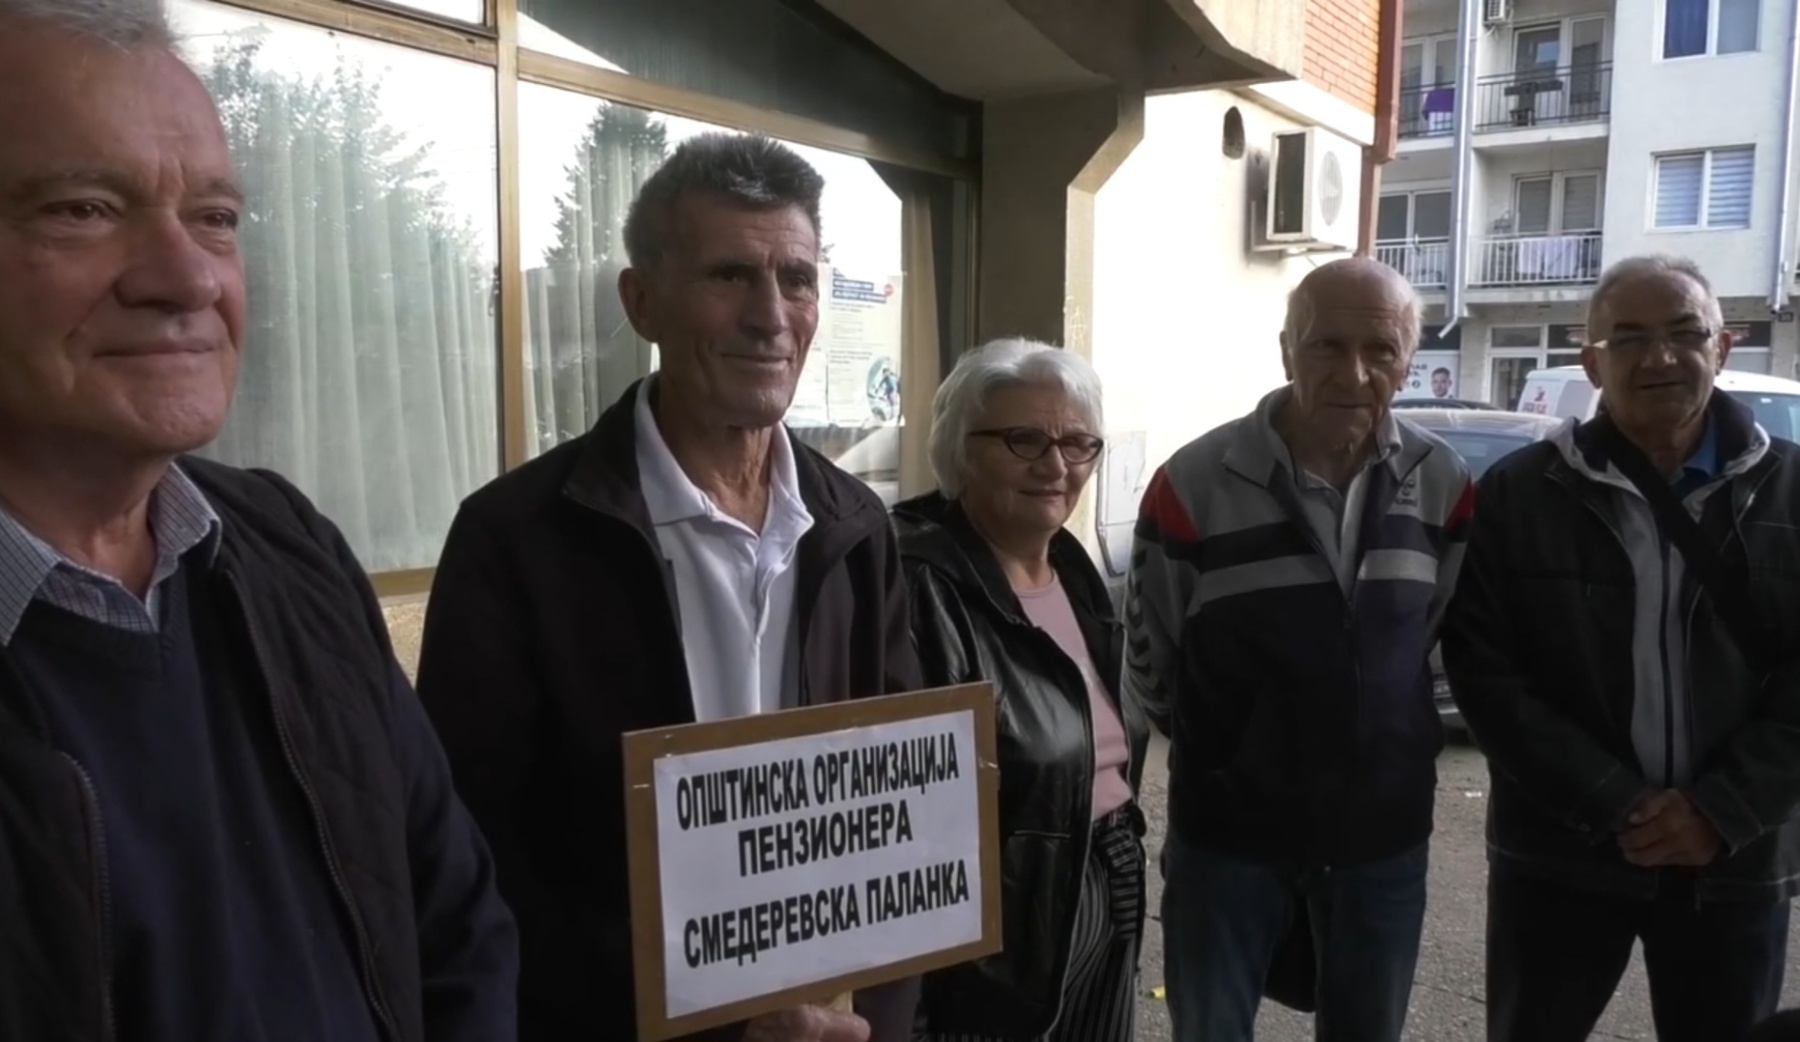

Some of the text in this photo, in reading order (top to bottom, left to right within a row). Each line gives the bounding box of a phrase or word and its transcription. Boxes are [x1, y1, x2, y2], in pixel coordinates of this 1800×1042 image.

[676, 731, 959, 831] ОПШТИНСКА ОРГАНИЗАЦИЈА
[738, 799, 913, 877] ПЕНЗИОНЕРА
[683, 858, 970, 969] СМЕДЕРЕВСКА ПАЛАНКА
